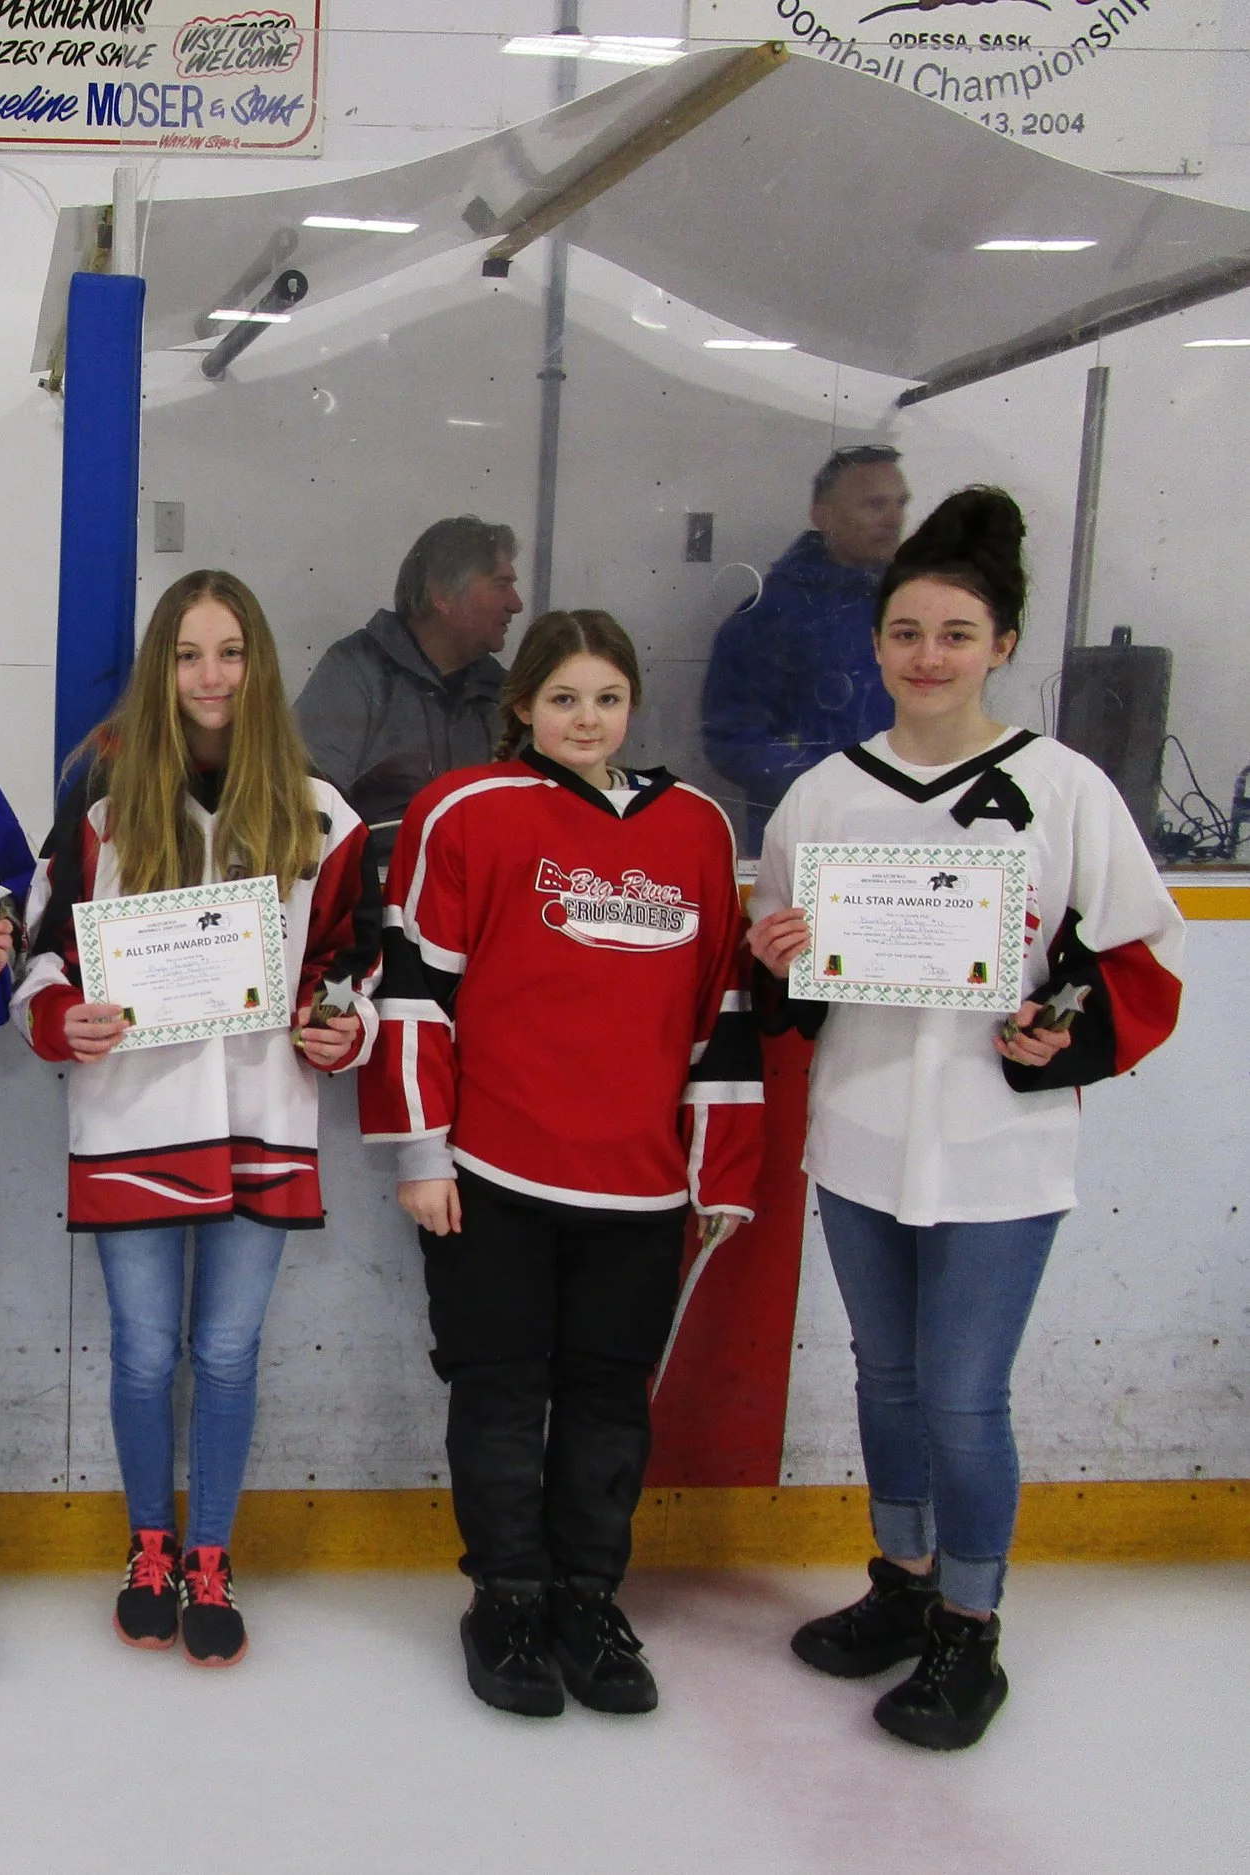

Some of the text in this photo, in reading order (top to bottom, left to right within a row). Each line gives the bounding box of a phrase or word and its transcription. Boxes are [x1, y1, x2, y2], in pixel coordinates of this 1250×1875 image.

[180, 18, 291, 53] VISITORS
[978, 33, 1033, 52] SASK
[46, 39, 96, 67] FOR
[95, 42, 158, 70] SALE
[185, 41, 299, 74] WELCOME
[86, 82, 204, 129] MOSER
[209, 98, 225, 118] &
[1021, 112, 1086, 136] 2004
[570, 867, 682, 908] Big River
[843, 895, 974, 909] ALL STAR AWARD 2020
[563, 897, 686, 933] CRUSADERS
[125, 933, 239, 958] ALL STAR AWARD 2020
